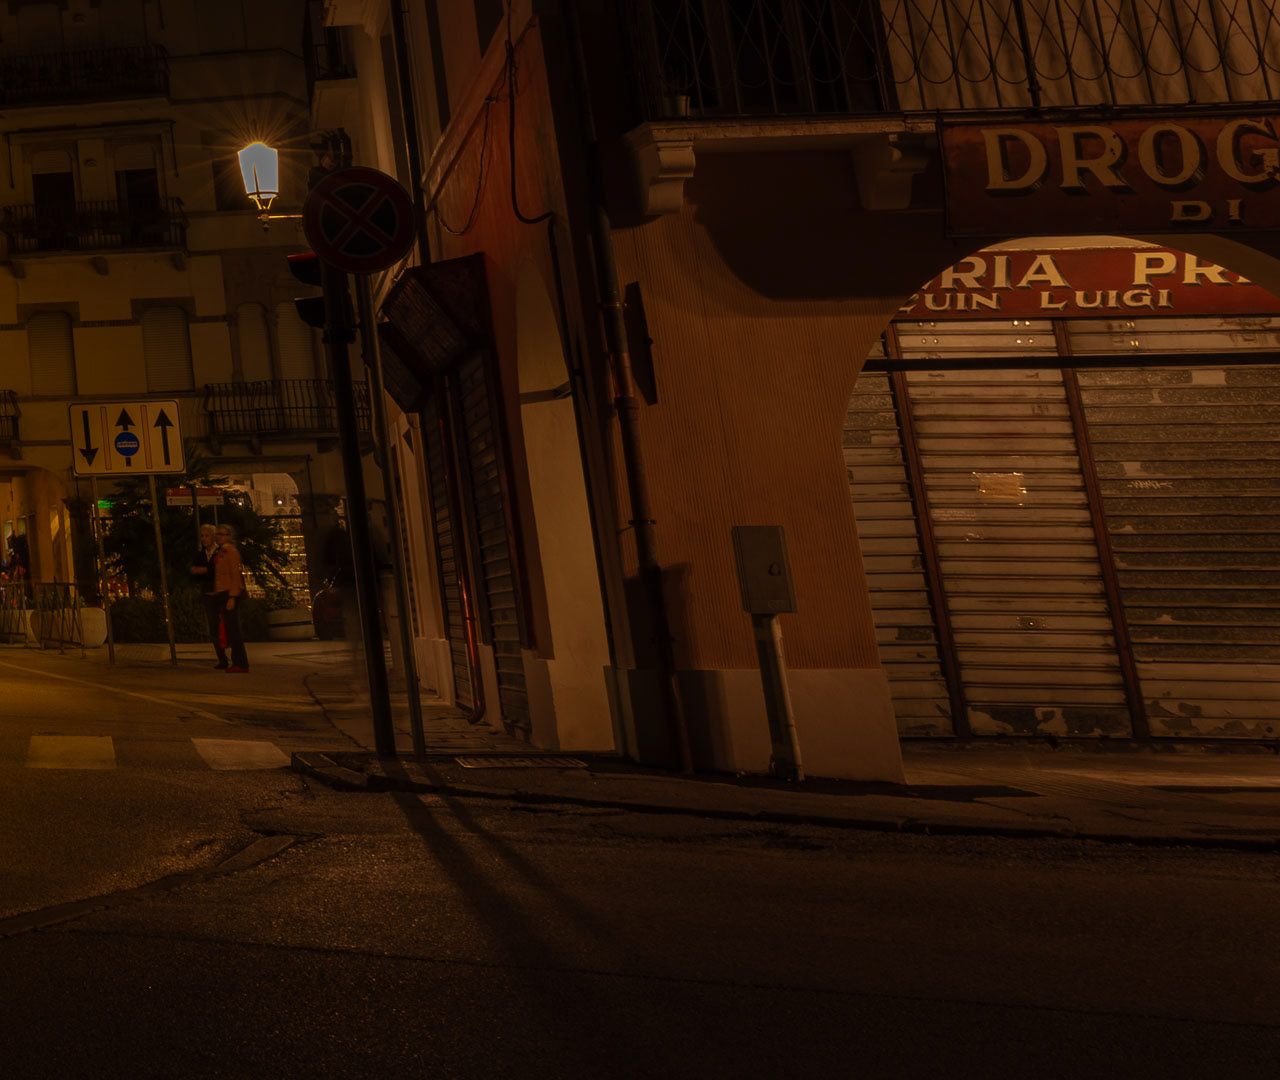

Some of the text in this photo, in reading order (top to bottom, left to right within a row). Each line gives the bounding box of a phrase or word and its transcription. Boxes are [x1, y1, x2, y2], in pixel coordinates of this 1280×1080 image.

[981, 117, 1280, 194] DROG
[1169, 200, 1243, 223] DI
[921, 251, 1252, 291] RIA PR
[1040, 288, 1176, 312] LUIGI
